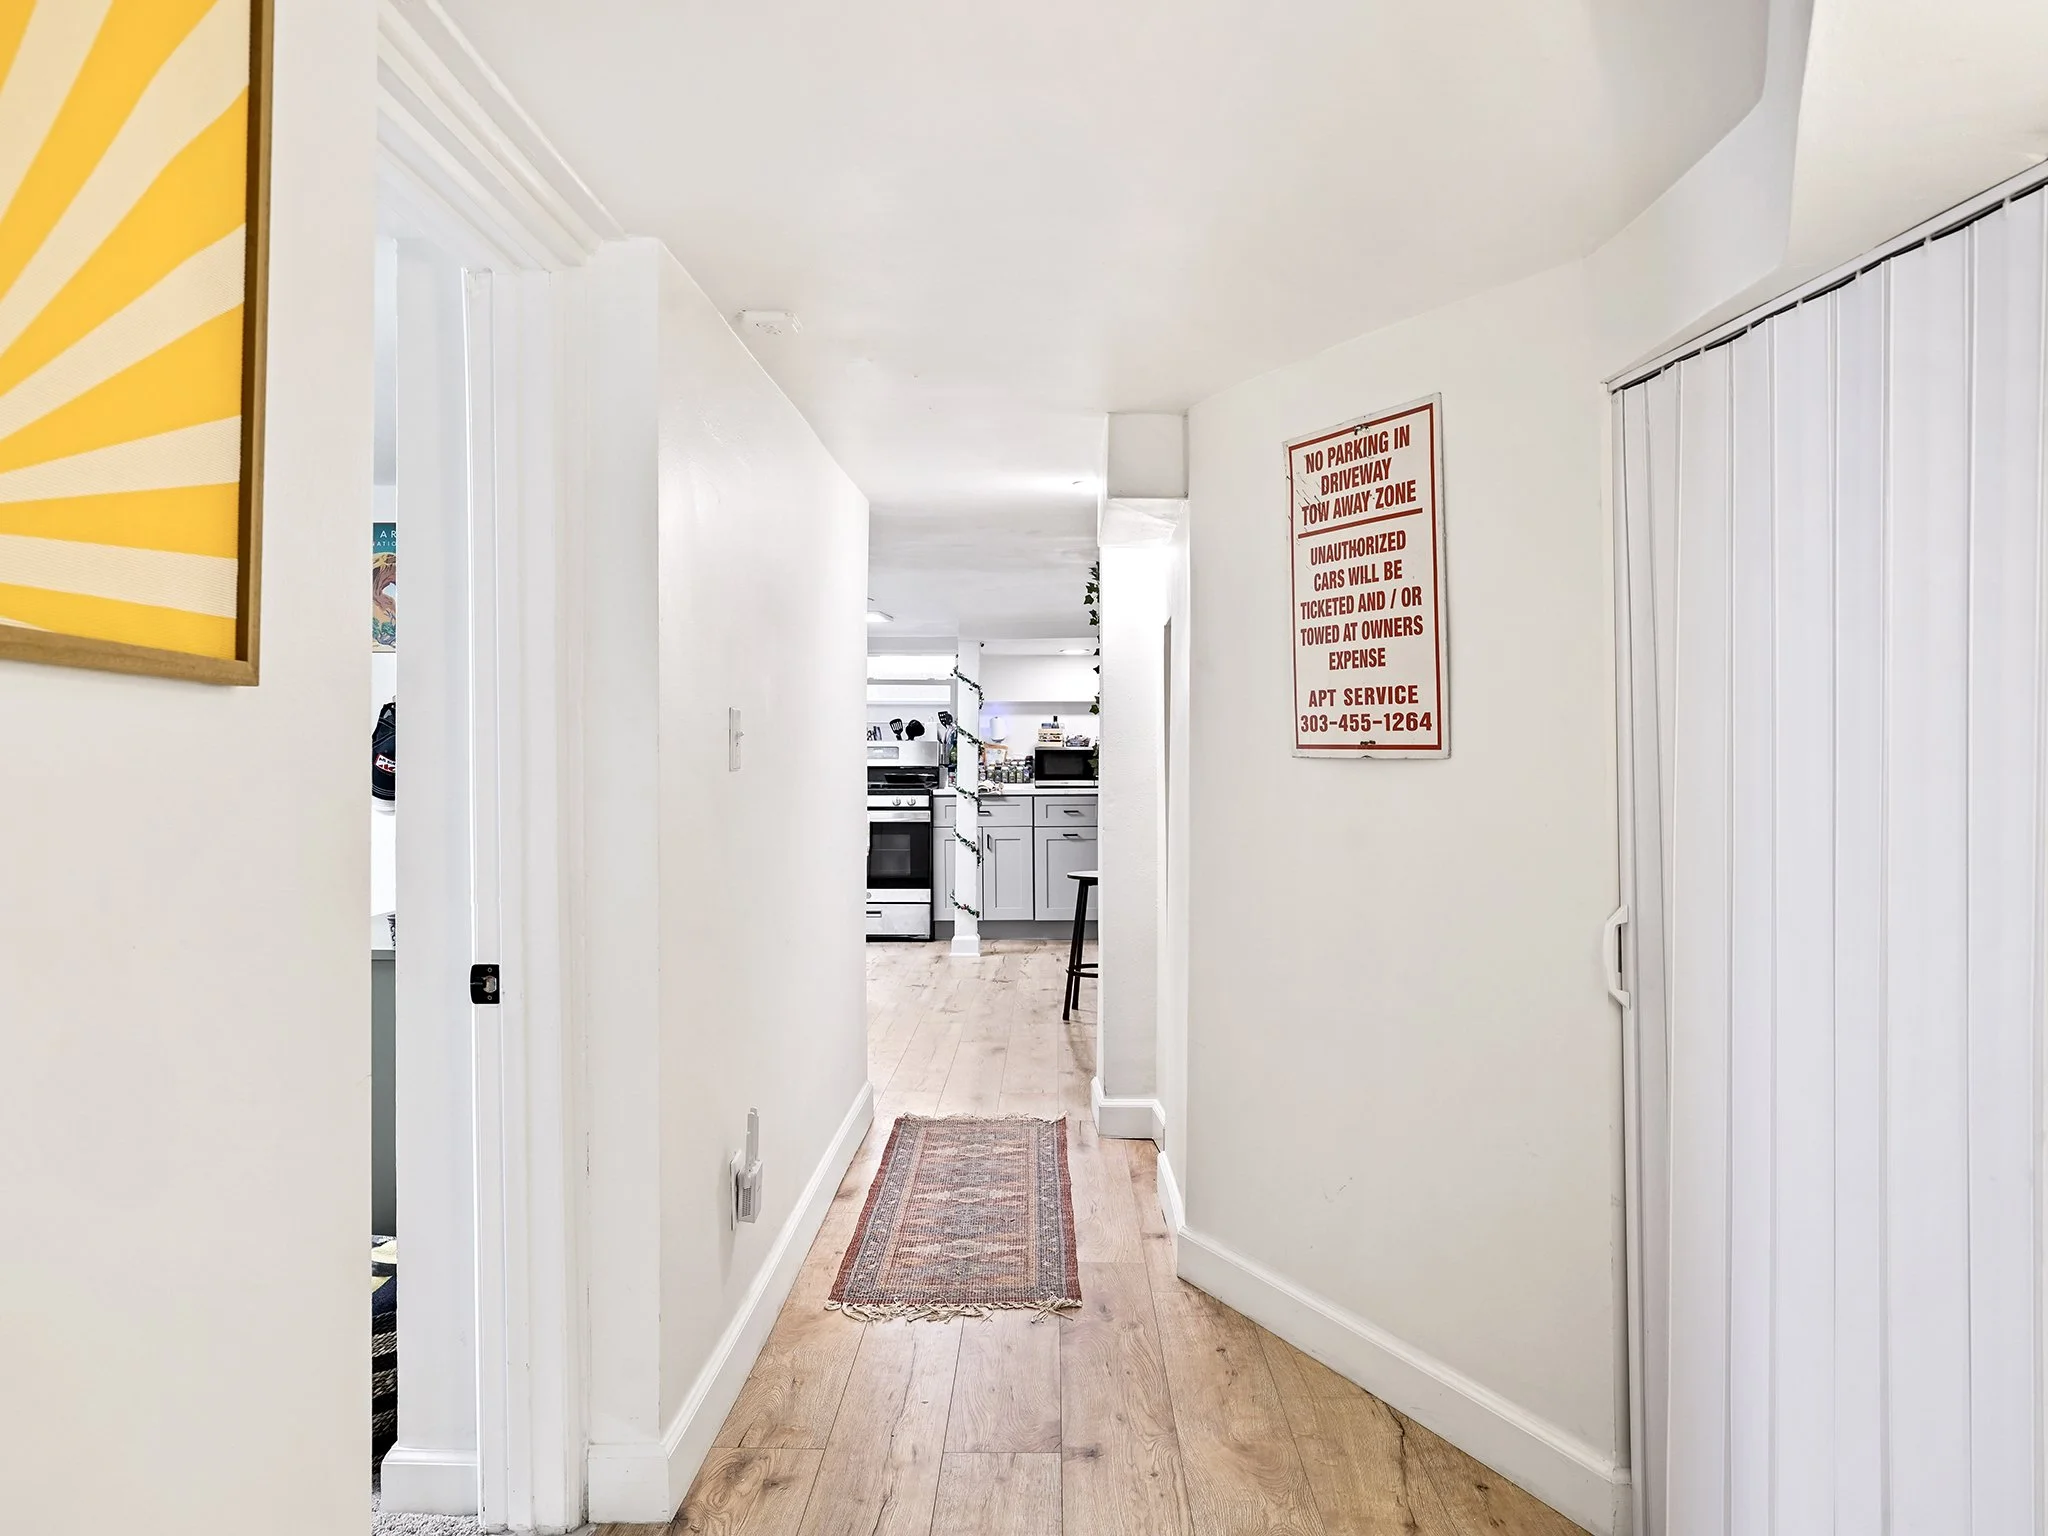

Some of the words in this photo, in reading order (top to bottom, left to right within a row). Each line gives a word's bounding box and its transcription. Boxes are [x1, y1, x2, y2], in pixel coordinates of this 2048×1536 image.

[1305, 450, 1323, 474] NO
[1327, 431, 1389, 466] PARKING
[1394, 424, 1410, 448] IN
[1320, 458, 1392, 496] DRIVEWAY
[1302, 501, 1330, 526] TOW
[1333, 491, 1371, 519] AWAY
[1375, 480, 1416, 510] ZONE
[1310, 530, 1406, 565] UNAUTHORIZED
[1314, 569, 1344, 592] CARS
[1348, 564, 1380, 585] WILL
[1383, 560, 1403, 581] BE
[1301, 596, 1354, 620] TICKETED
[1358, 591, 1386, 611] AND
[1390, 589, 1396, 609] /
[1401, 585, 1422, 608] OR
[1301, 625, 1340, 646] TOWED
[1343, 622, 1358, 641] AT
[1362, 615, 1423, 640] OWNERS
[1329, 648, 1386, 670] EXPENSE
[1309, 690, 1336, 707] APT
[1343, 684, 1418, 706] SERVICE
[1301, 712, 1432, 732] 303-455-1264
